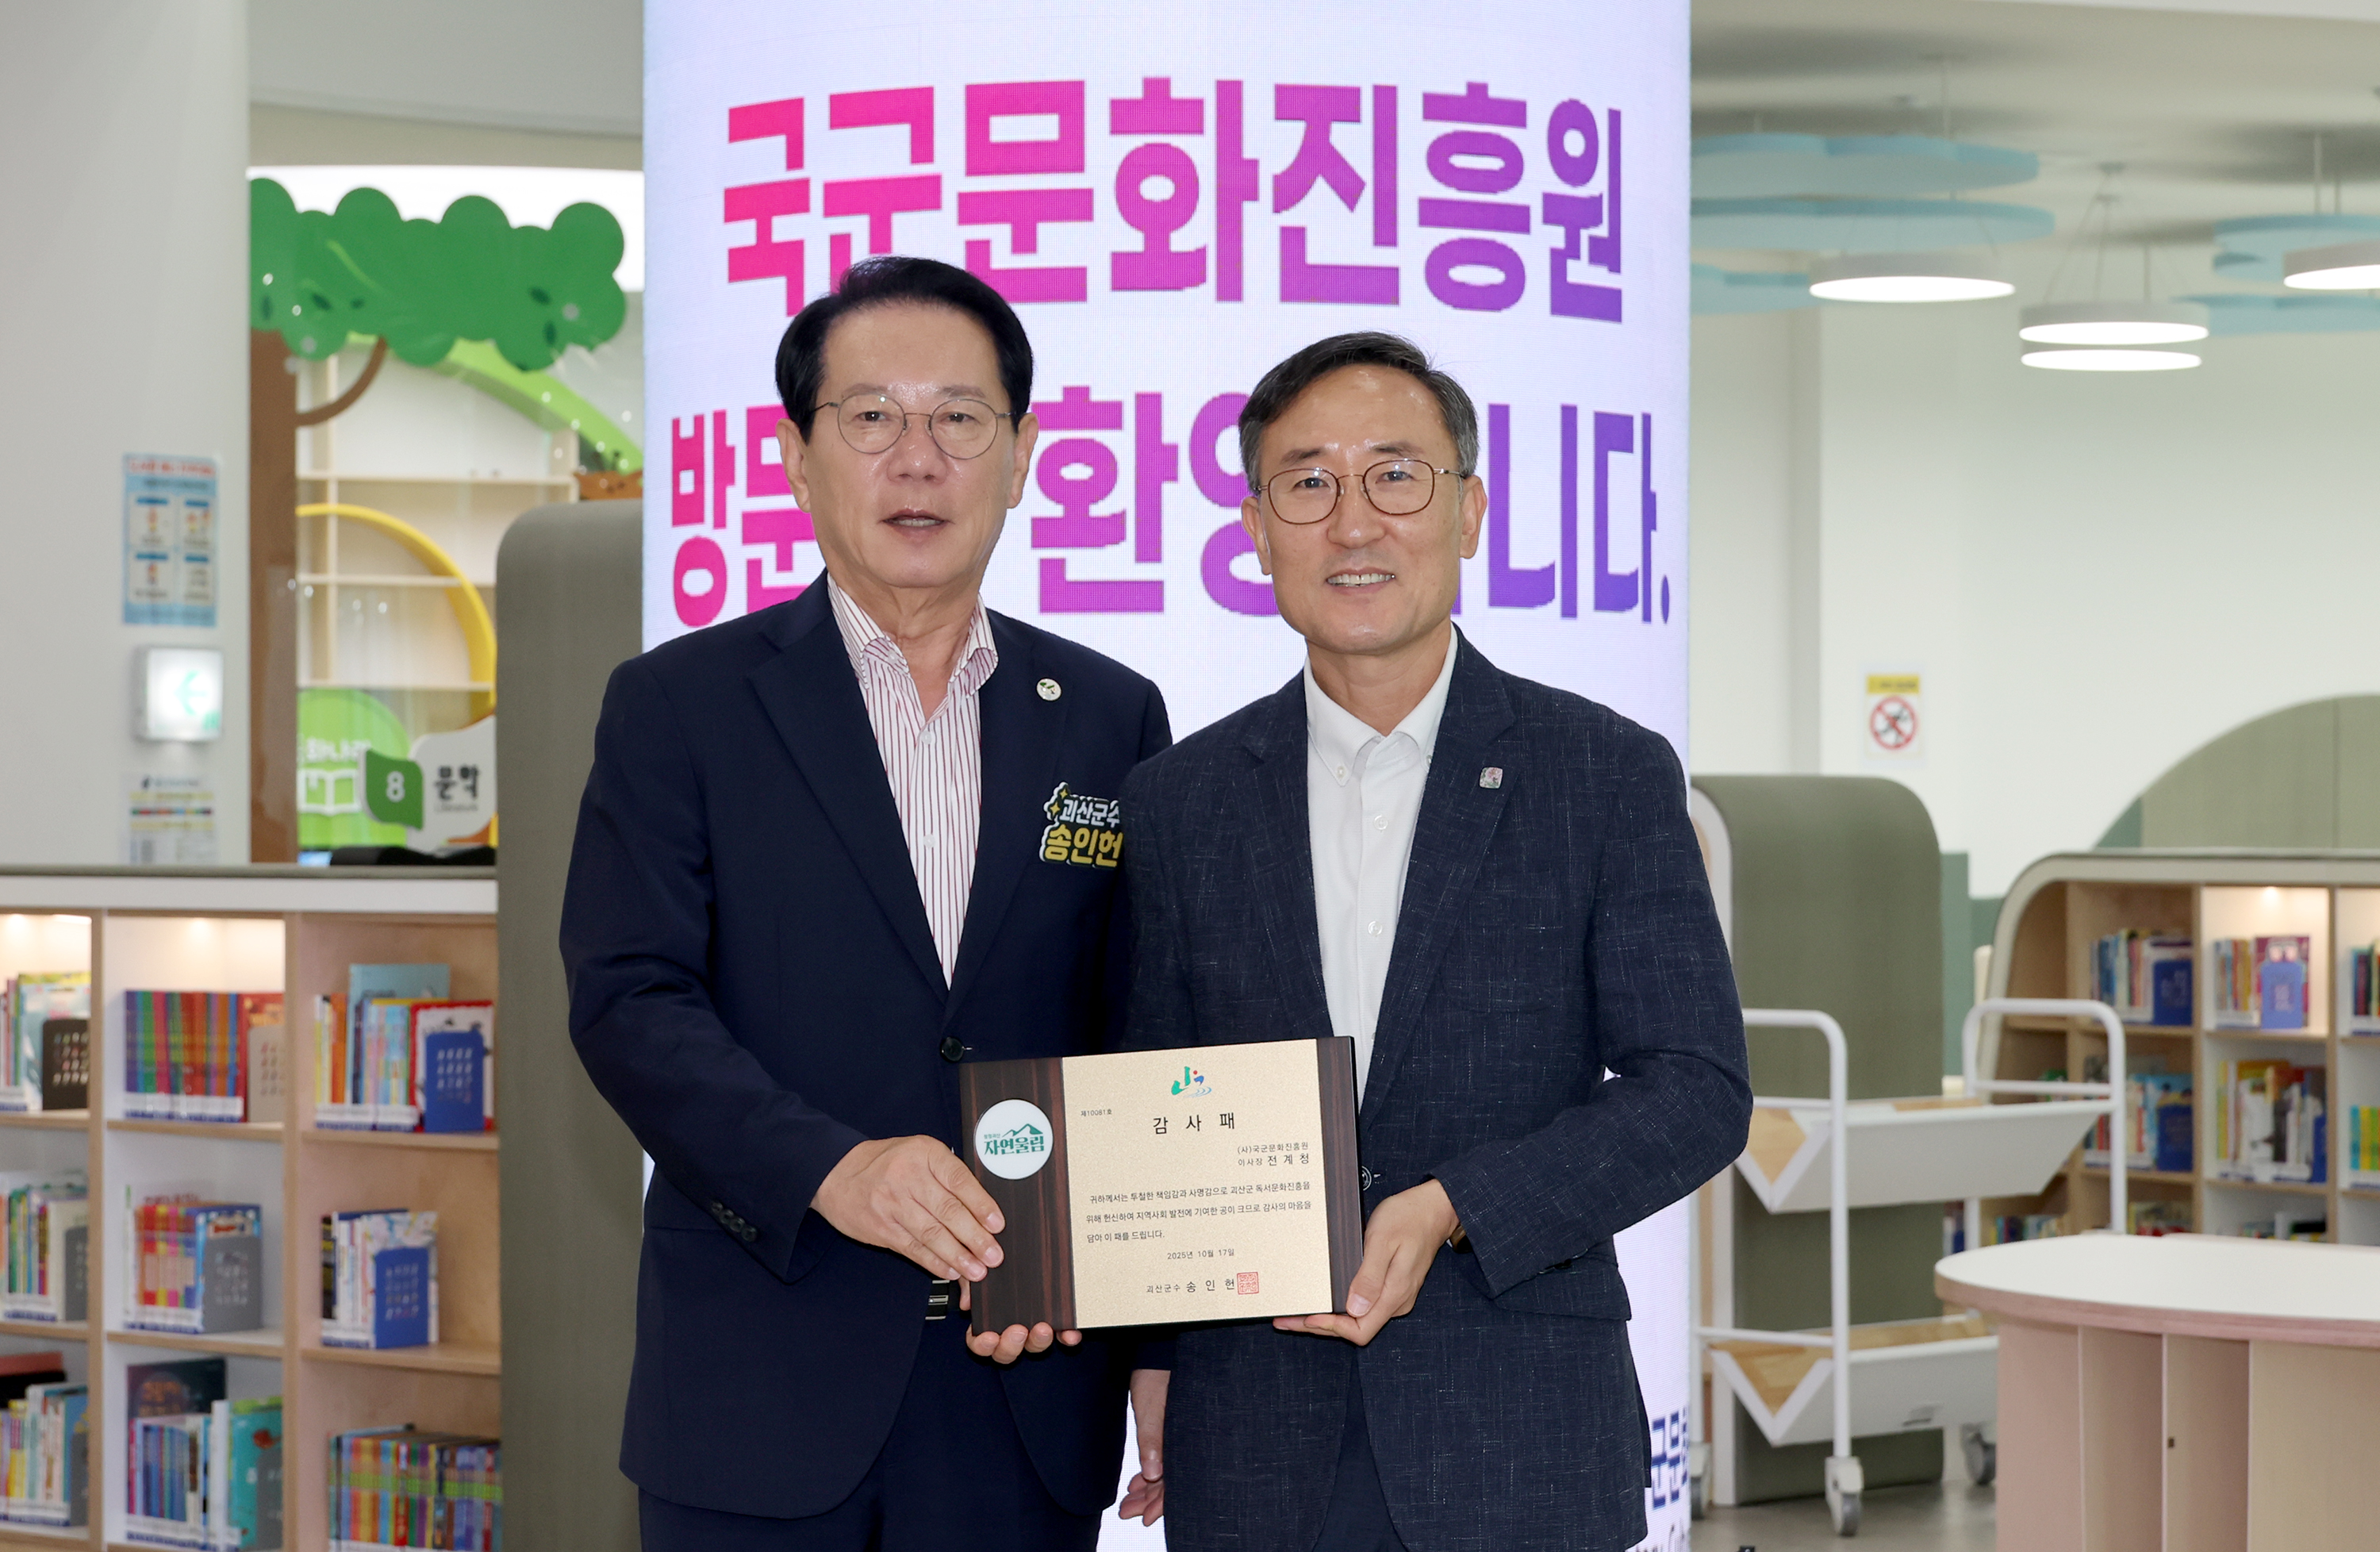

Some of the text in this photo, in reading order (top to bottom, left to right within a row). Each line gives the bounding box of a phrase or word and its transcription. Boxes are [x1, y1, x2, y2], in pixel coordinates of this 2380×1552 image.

[724, 76, 1623, 323] 국군문화진흥원
[671, 405, 819, 628] 방문
[386, 770, 405, 802] 8
[435, 763, 479, 801] 문학
[1059, 799, 1121, 828] 괴산군수
[1044, 823, 1124, 868] 송인헌
[984, 1135, 1045, 1155] 자연울림
[1238, 1142, 1308, 1154] (사)국군문화진흥원
[1238, 1158, 1263, 1166] 이사장
[1090, 1181, 1311, 1204] 귀하께서는 투철한 책임감과 사명감으로 괴산군 독서문화진흥을
[1086, 1200, 1311, 1224] 위해 헌신하여 지역사회 발전에 기여한 공이 크므로 감사의 마음을
[1087, 1230, 1165, 1243] 담아 이 패를 드립니다.
[1167, 1250, 1193, 1260] 2025년
[1219, 1248, 1234, 1257] 17일
[1146, 1284, 1180, 1293] 괴산군수
